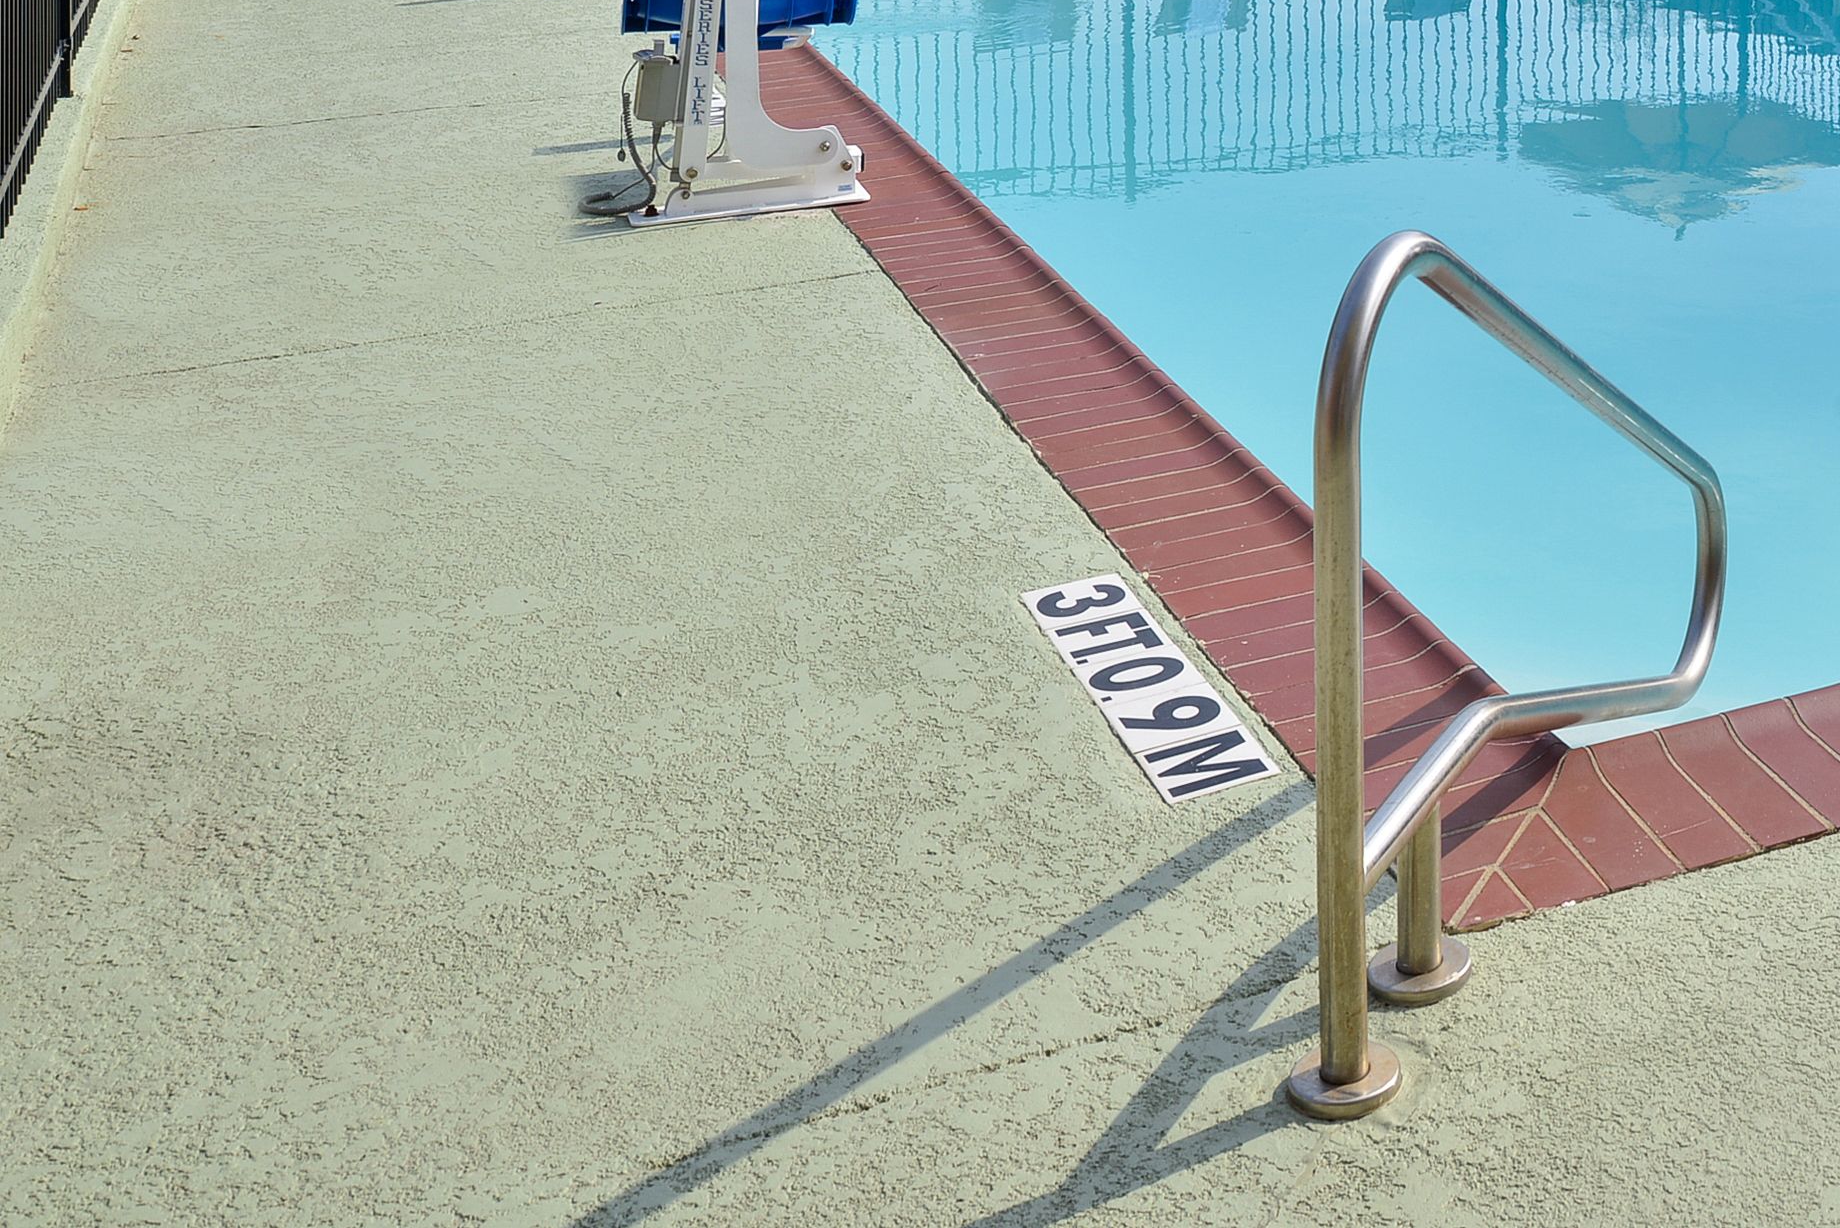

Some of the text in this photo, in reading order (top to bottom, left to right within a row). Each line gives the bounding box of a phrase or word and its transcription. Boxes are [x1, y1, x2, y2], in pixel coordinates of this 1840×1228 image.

[691, 76, 706, 122] LIFT
[1036, 583, 1127, 618] 3
[1143, 729, 1270, 799] M
